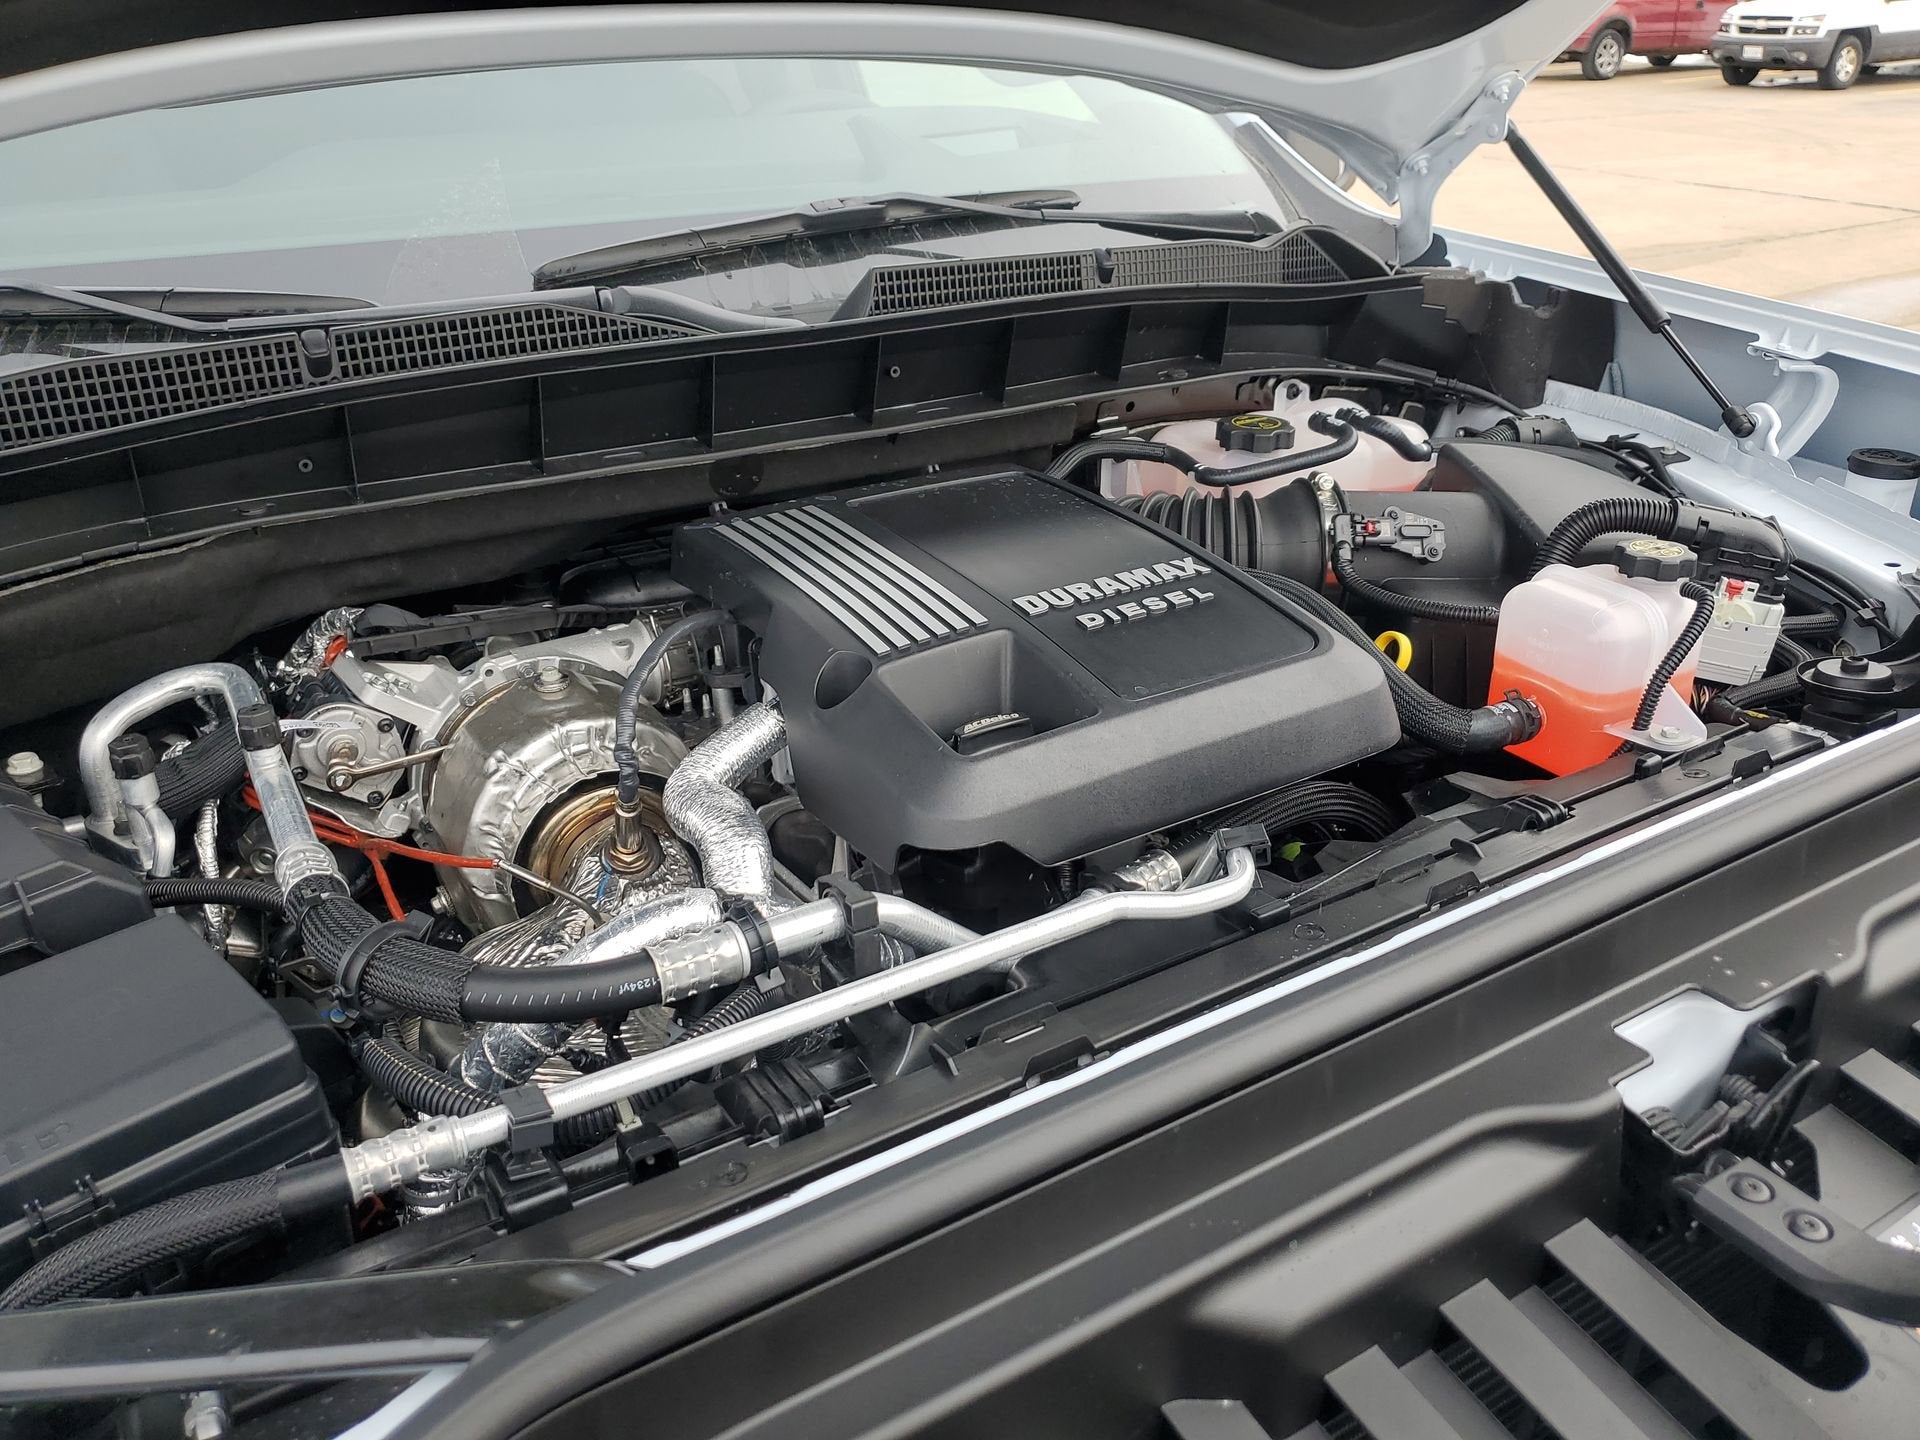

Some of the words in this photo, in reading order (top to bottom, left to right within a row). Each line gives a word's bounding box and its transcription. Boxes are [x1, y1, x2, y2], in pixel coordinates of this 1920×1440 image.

[1011, 556, 1212, 616] DURAMAX
[1075, 586, 1215, 630] DIESEL
[963, 712, 1020, 734] ACDelco
